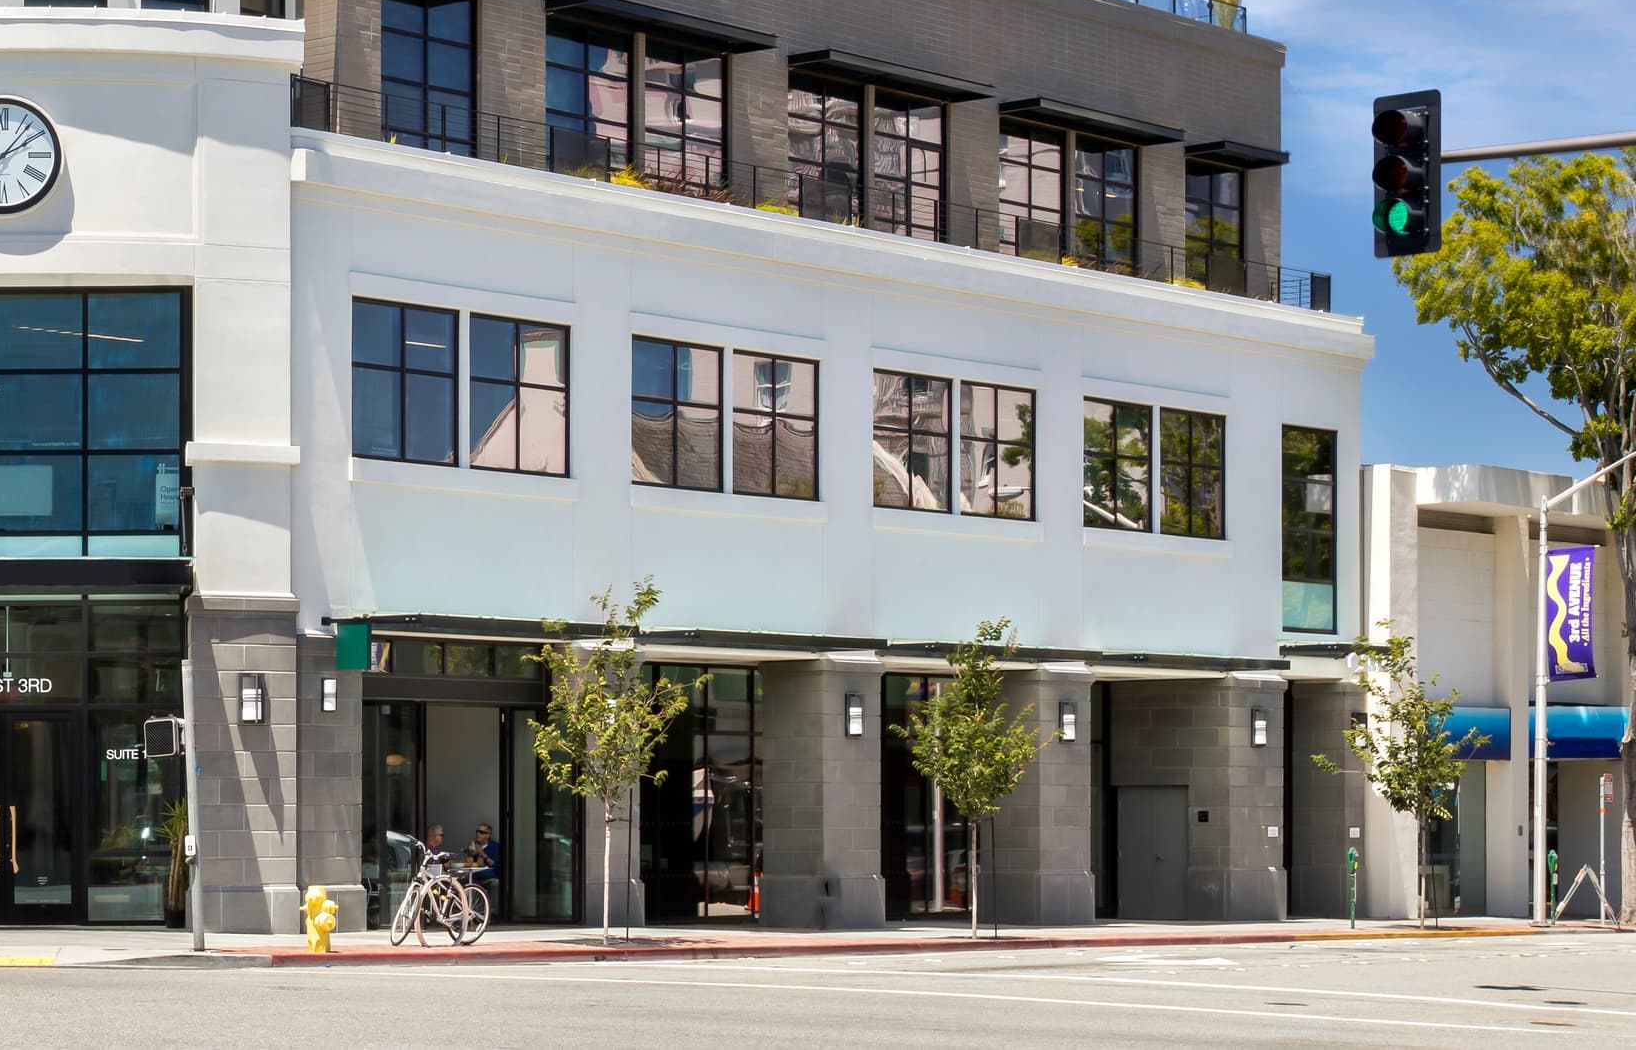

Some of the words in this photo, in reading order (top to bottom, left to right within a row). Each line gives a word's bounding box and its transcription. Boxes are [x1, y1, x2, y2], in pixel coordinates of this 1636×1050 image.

[1568, 562, 1582, 616] AVENUE
[1581, 612, 1590, 627] the
[1568, 618, 1580, 643] 3rd
[18, 678, 52, 693] 3RD
[106, 749, 140, 760] SUITE
